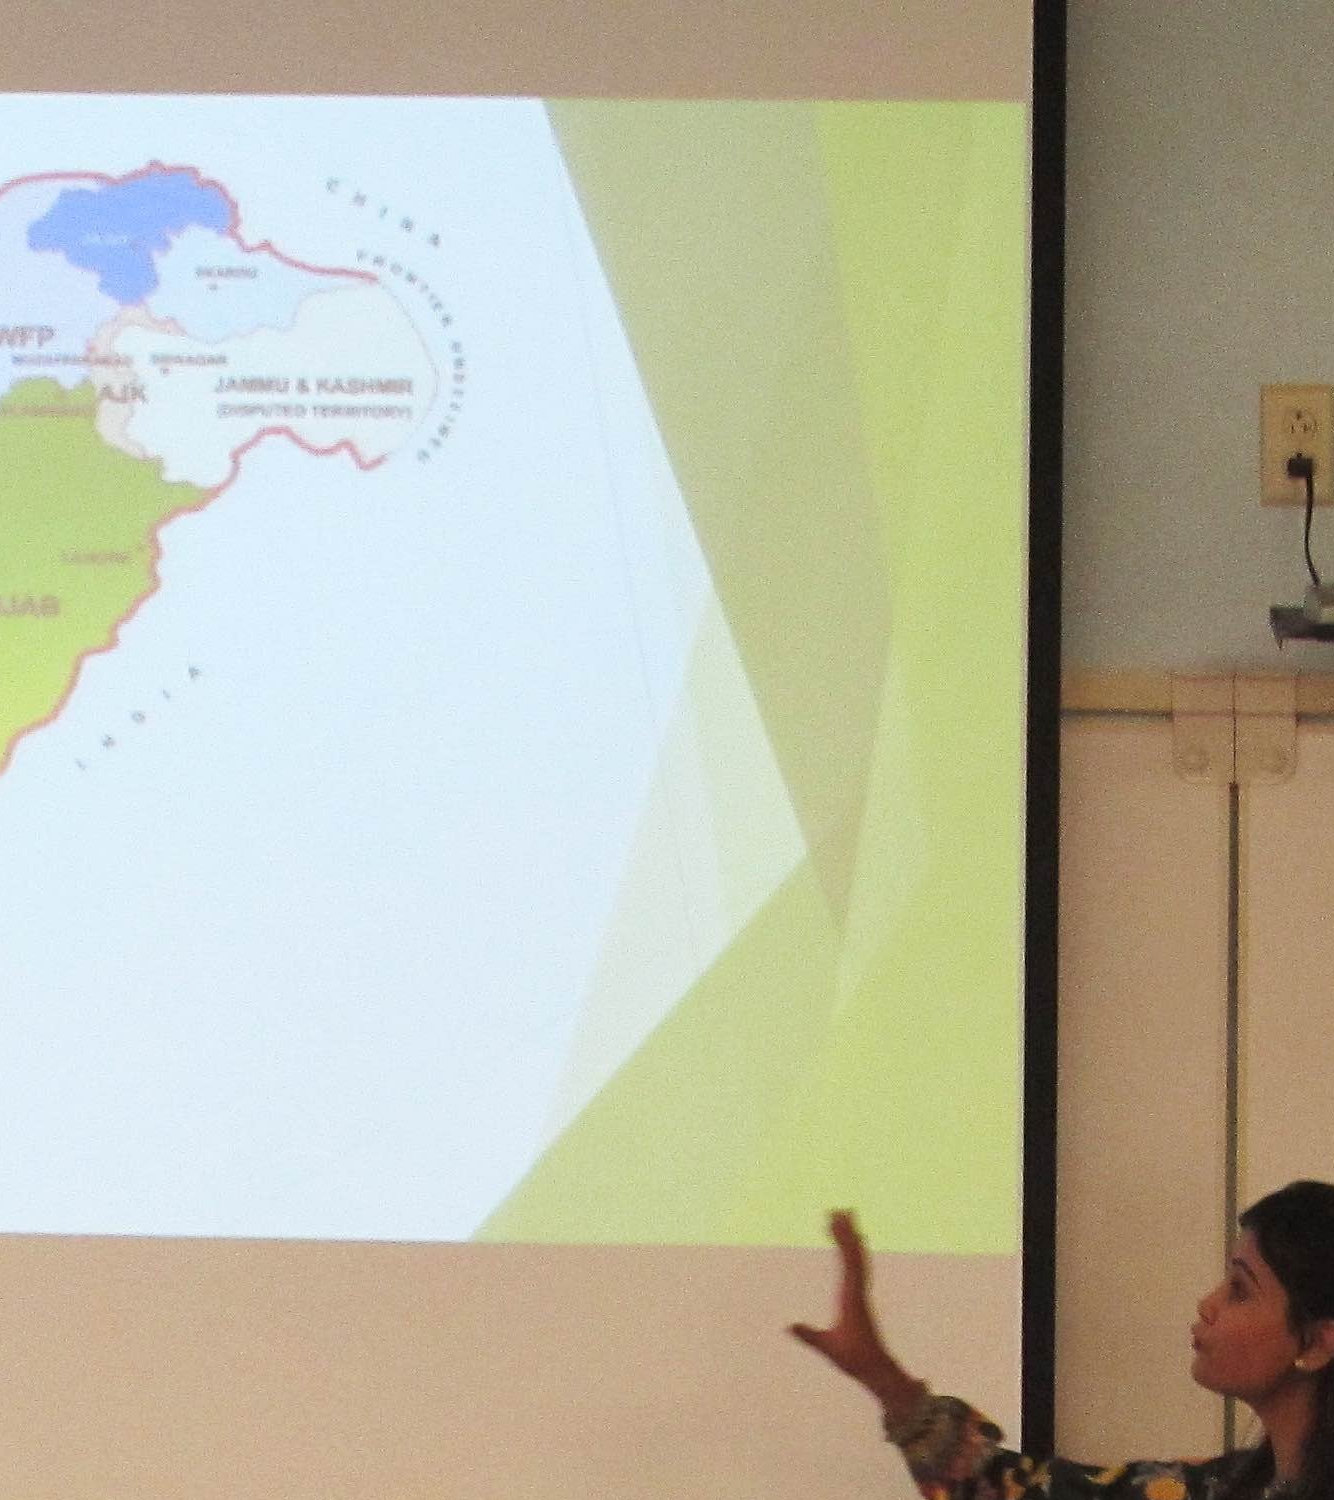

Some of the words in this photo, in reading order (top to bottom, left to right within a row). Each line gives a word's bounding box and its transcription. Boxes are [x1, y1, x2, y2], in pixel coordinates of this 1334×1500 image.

[215, 377, 289, 394] JAMMU
[296, 378, 310, 393] &
[316, 378, 413, 395] KASHMIR
